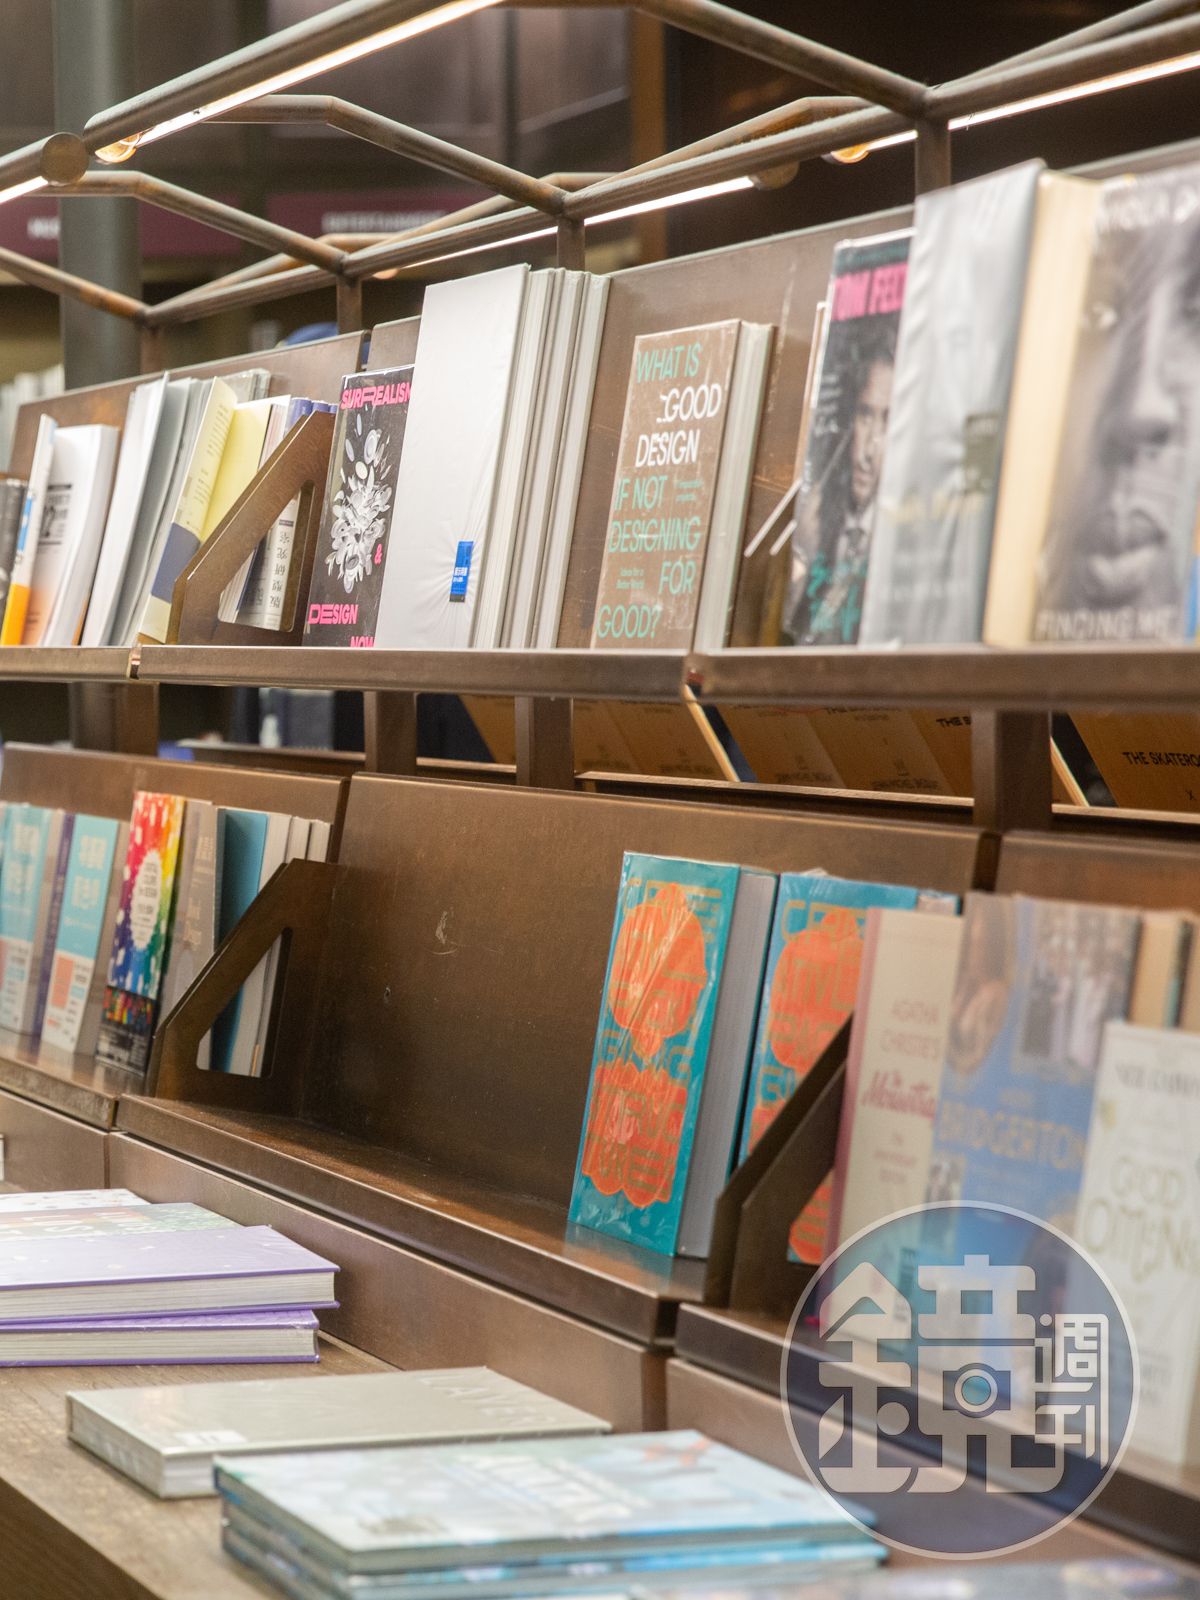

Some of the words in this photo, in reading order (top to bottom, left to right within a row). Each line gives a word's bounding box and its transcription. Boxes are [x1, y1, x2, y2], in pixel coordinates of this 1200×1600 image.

[636, 346, 685, 383] WHAT
[684, 342, 702, 377] IS
[658, 383, 722, 423] GOOD
[635, 429, 701, 468] DESIGN
[614, 478, 630, 511] IF
[632, 475, 668, 510] NOT
[608, 516, 702, 553] DESIGNING
[658, 560, 697, 595] FOR
[308, 603, 359, 625] DESIGN
[596, 605, 662, 638] GOOD?
[1122, 752, 1149, 765] THE
